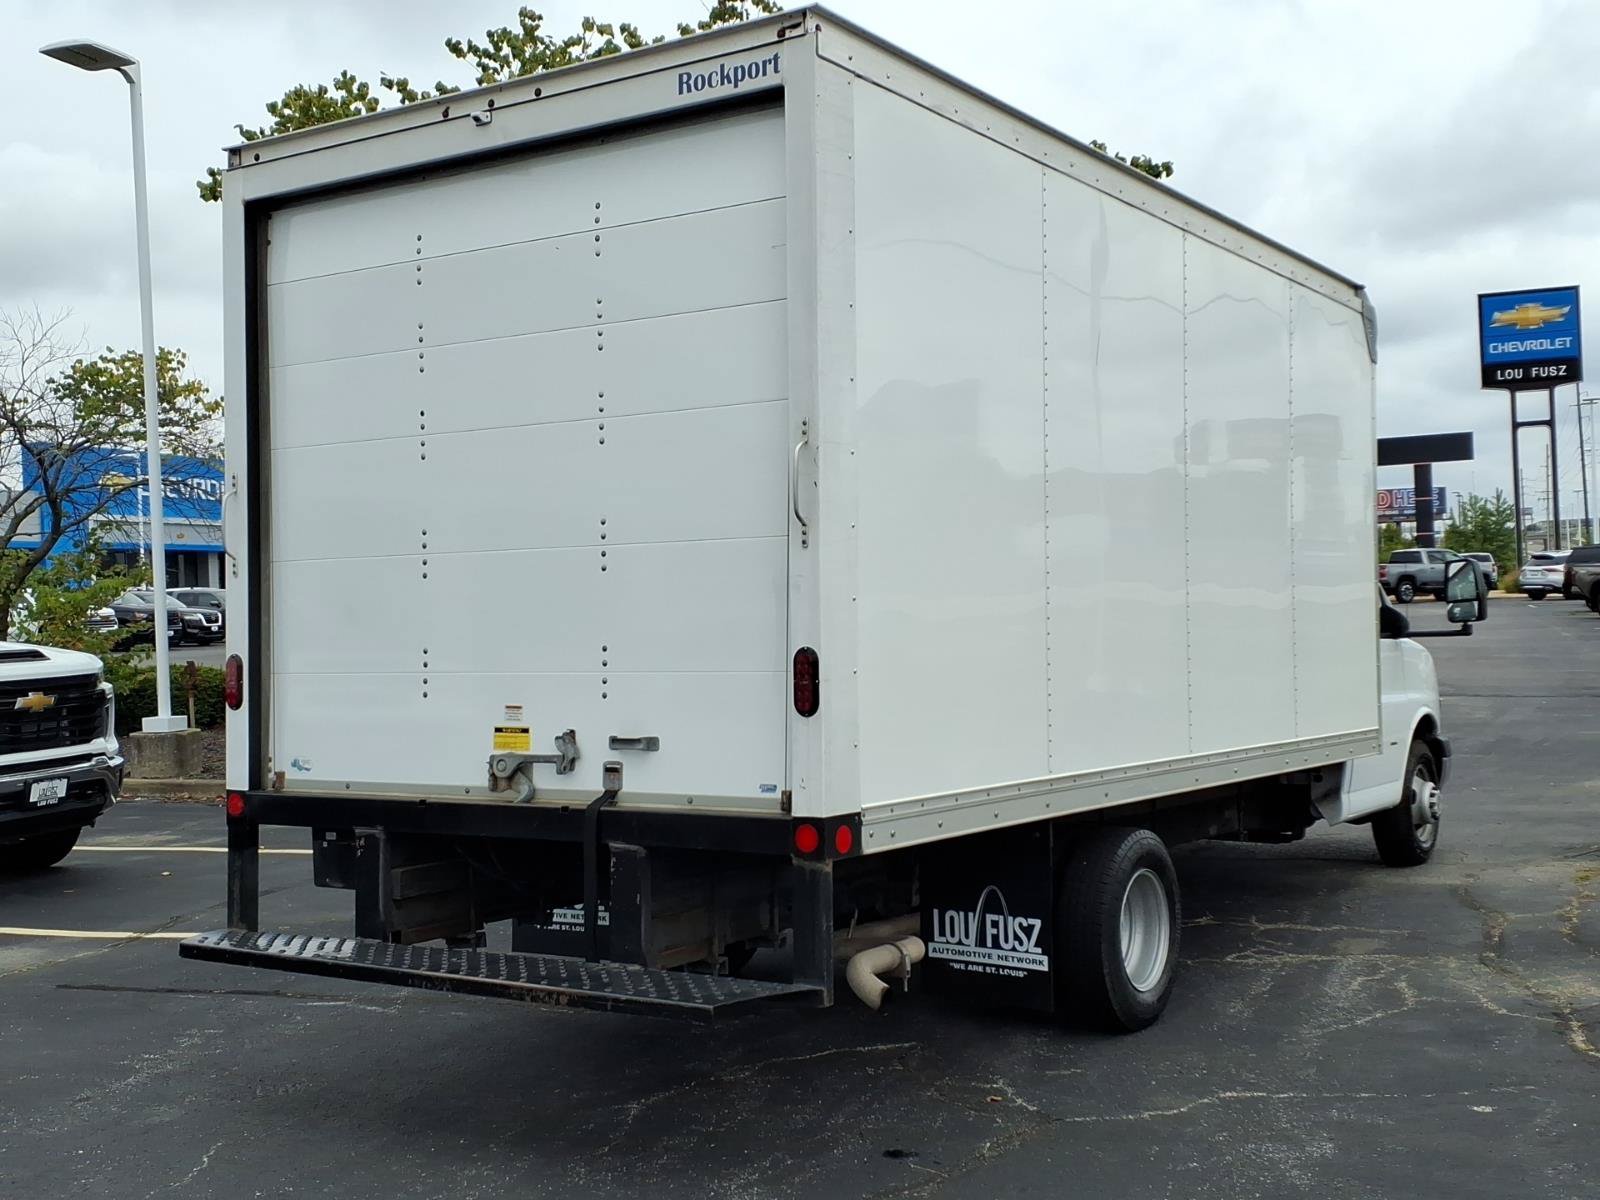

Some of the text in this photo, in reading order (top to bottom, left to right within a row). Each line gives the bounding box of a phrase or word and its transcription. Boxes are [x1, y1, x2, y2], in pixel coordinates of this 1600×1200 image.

[678, 52, 780, 95] Rockport
[1489, 337, 1573, 354] CHEVROLET
[1497, 365, 1567, 380] LOU FUSZ
[933, 908, 1042, 954] LOU FUSZ
[931, 946, 1045, 967] AUTOMOTIVE NETWORK
[967, 964, 983, 972] ARE
[985, 966, 998, 974] ST.
